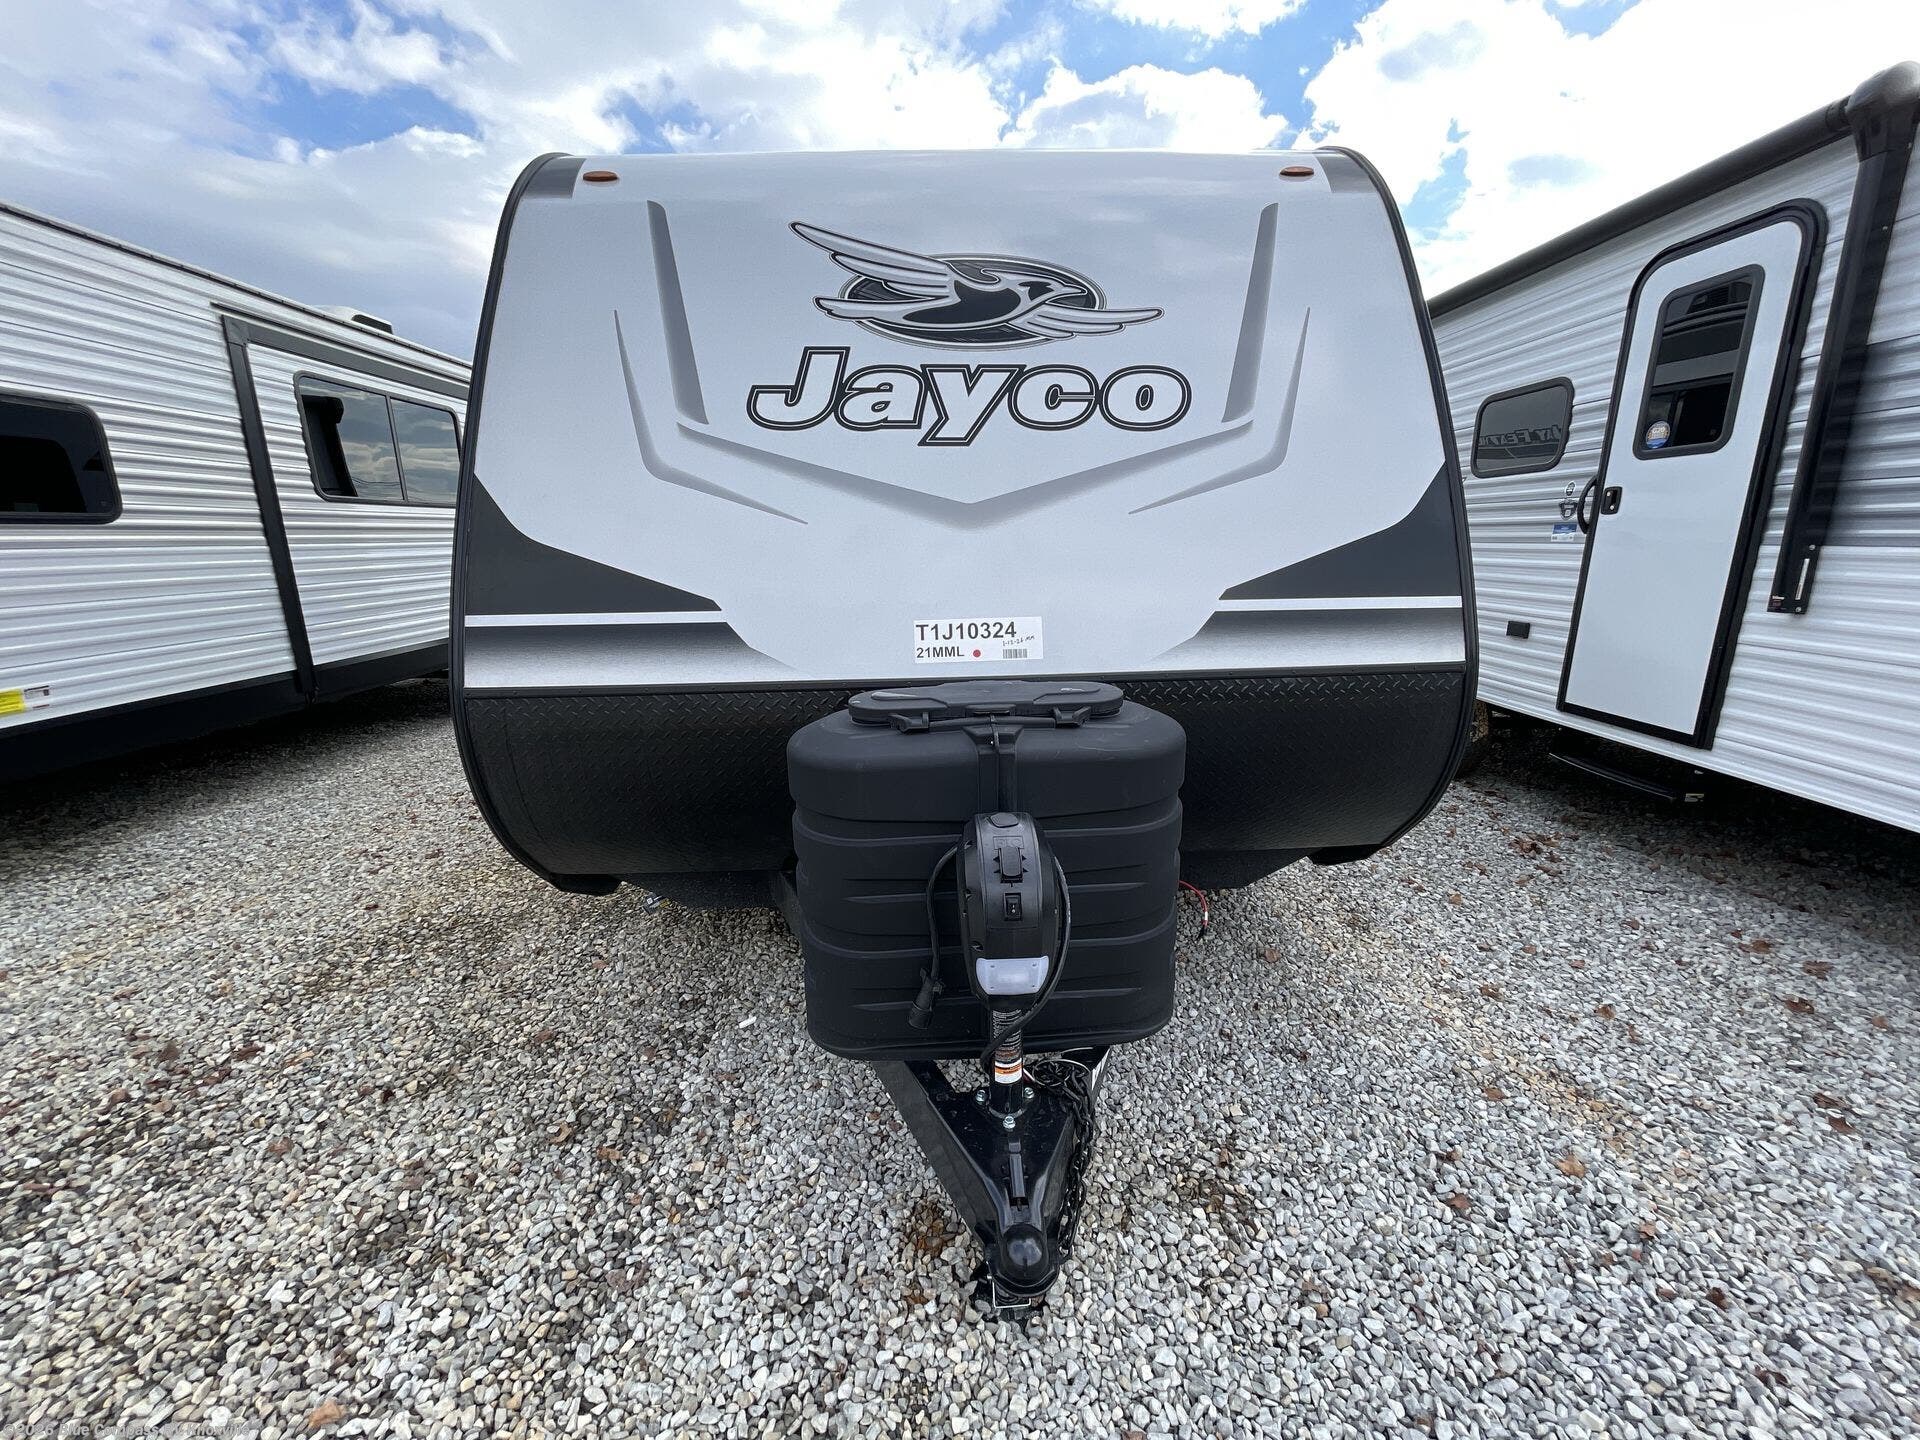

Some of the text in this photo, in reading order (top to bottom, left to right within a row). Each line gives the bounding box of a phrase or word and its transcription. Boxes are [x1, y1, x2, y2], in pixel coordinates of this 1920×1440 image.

[746, 346, 1192, 446] Jayco
[915, 621, 1017, 641] T1J10324
[916, 646, 965, 659] 21MML
